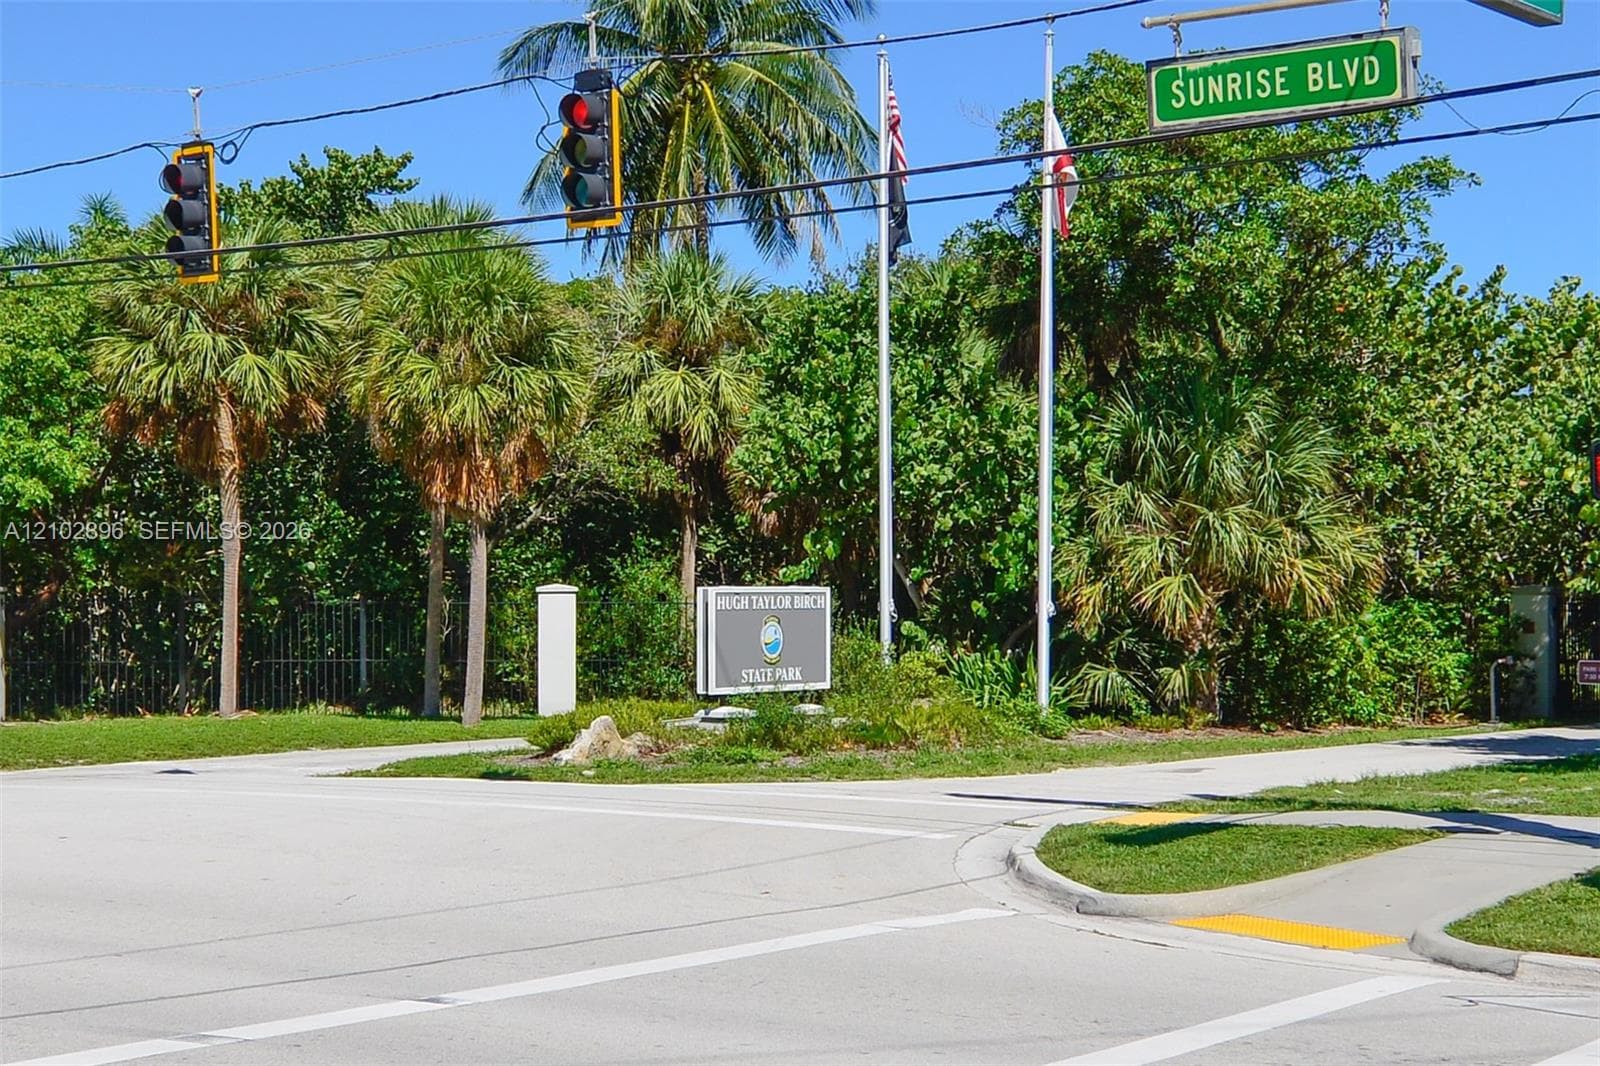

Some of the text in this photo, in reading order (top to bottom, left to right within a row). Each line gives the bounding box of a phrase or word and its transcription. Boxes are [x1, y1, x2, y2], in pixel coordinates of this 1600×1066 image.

[1170, 55, 1380, 109] SUNRISE BLVD
[716, 595, 825, 610] HUGH TAYLOR BIRCH
[741, 667, 803, 683] STATE PARK
